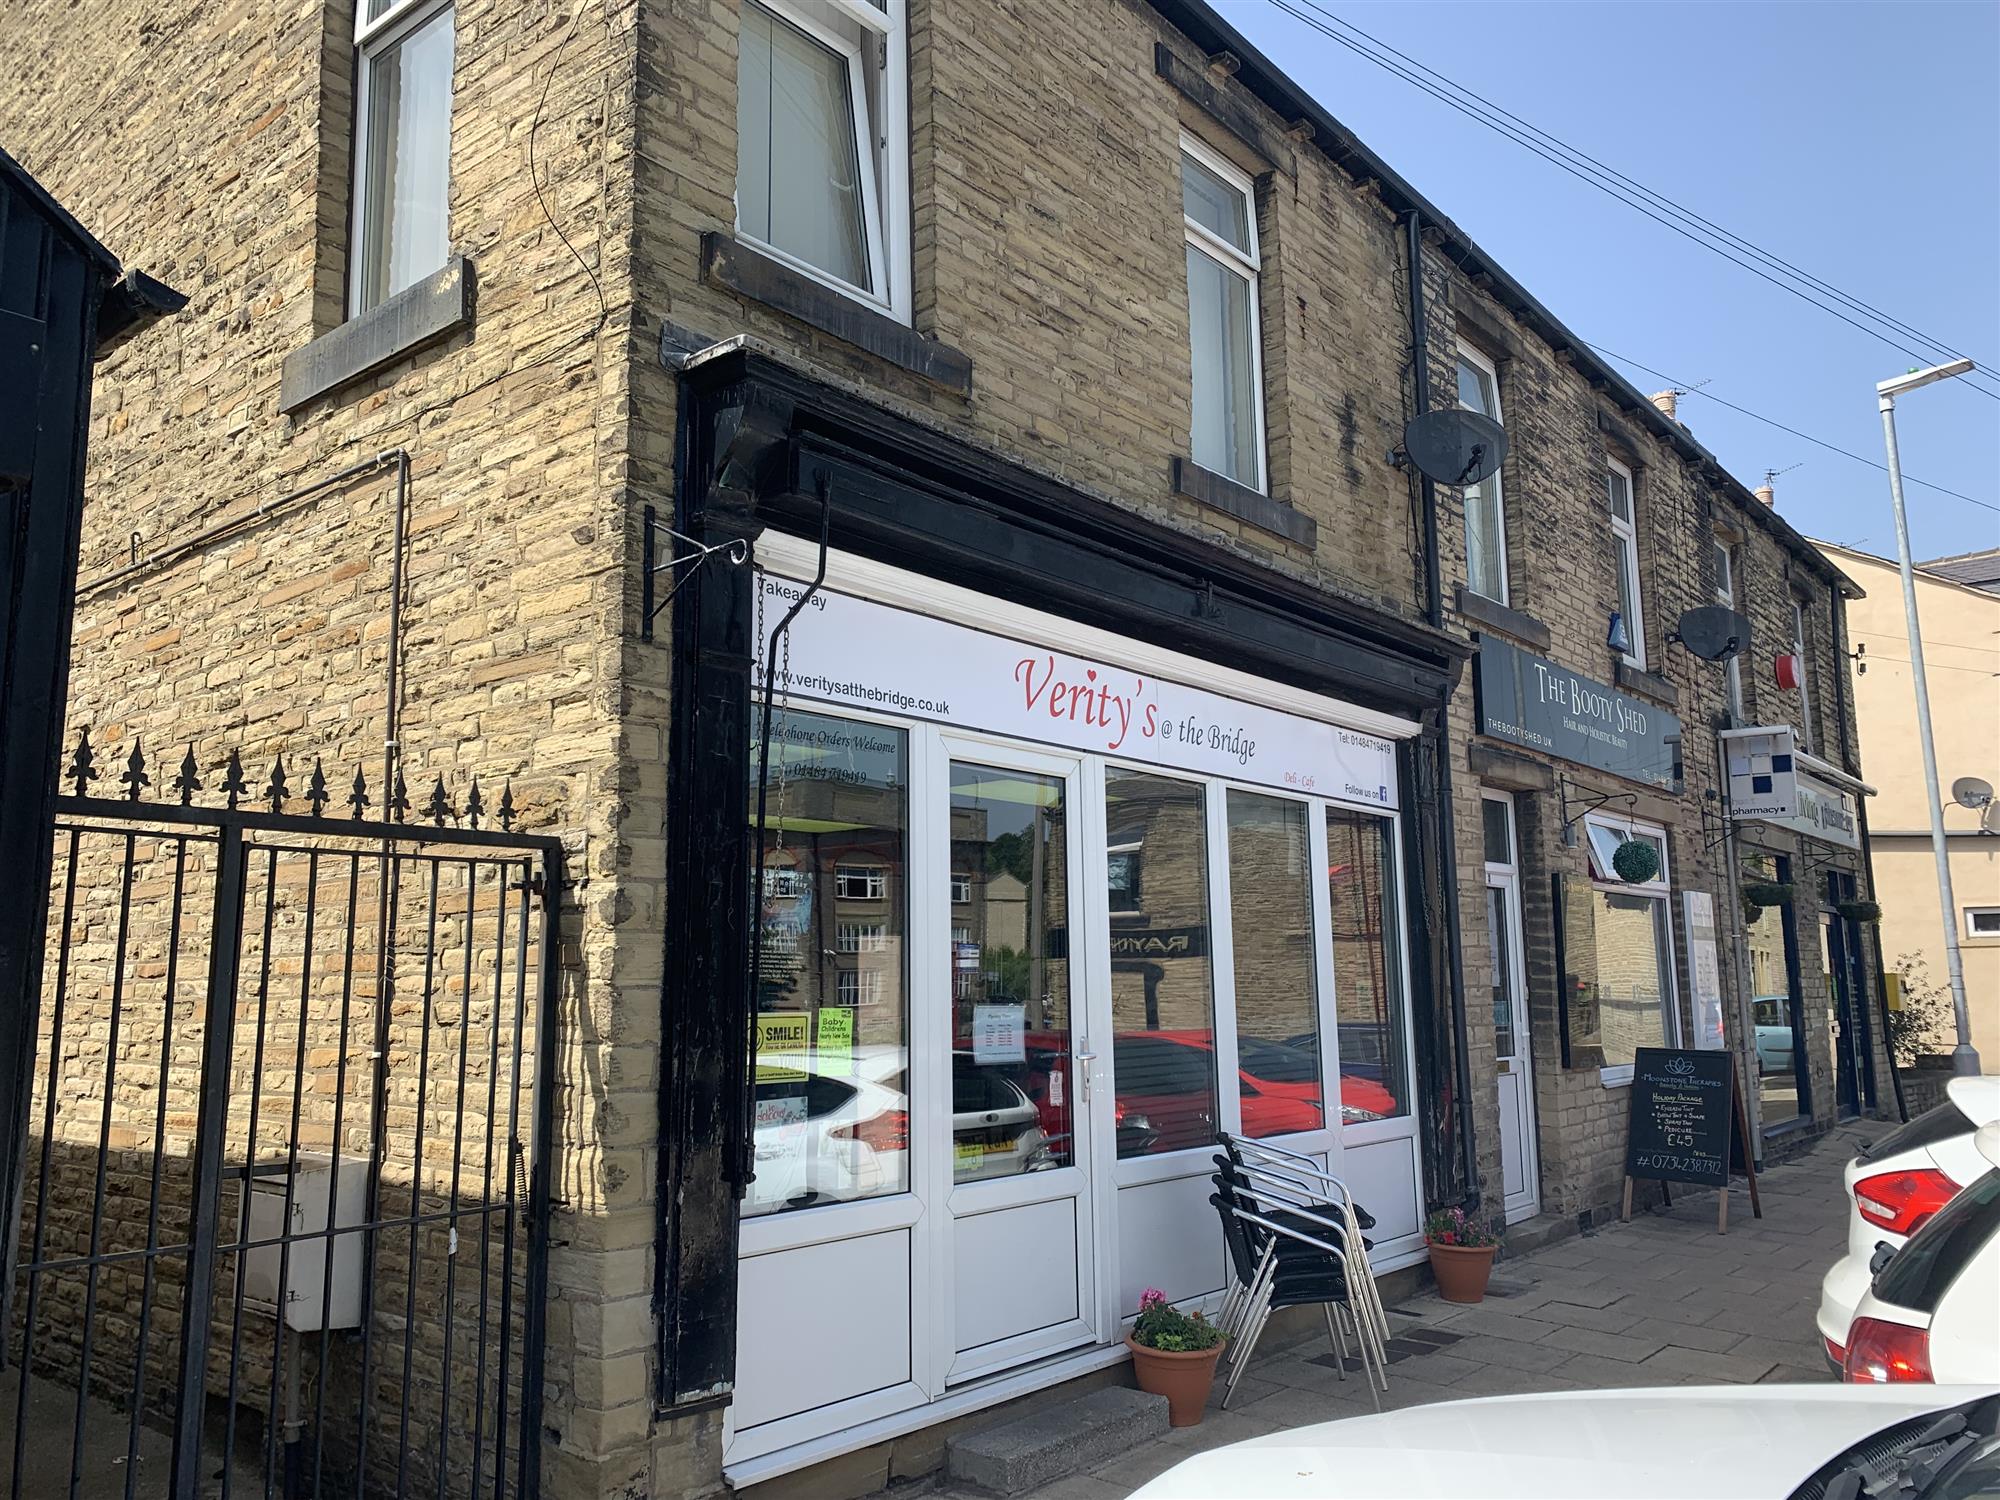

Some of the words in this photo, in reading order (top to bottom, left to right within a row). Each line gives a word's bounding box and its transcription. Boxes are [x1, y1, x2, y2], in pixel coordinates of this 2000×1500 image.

[757, 577, 827, 611] Takeaay
[1015, 656, 1158, 750] Verity's
[1161, 719, 1174, 739] @
[1179, 716, 1204, 746] the
[1208, 724, 1257, 765] Bridge
[767, 721, 815, 742] elephone
[817, 729, 851, 748] Orders
[852, 736, 896, 754] Welcome
[1338, 732, 1350, 745] Tel:
[1350, 735, 1391, 754] 01484719419
[1345, 783, 1363, 799] Follow
[1364, 789, 1372, 798] us
[1371, 790, 1380, 799] on
[1732, 807, 1780, 817] pharmacy
[822, 1018, 845, 1027] Baby
[766, 1026, 804, 1041] SMILE!
[1667, 1133, 1694, 1147] £45
